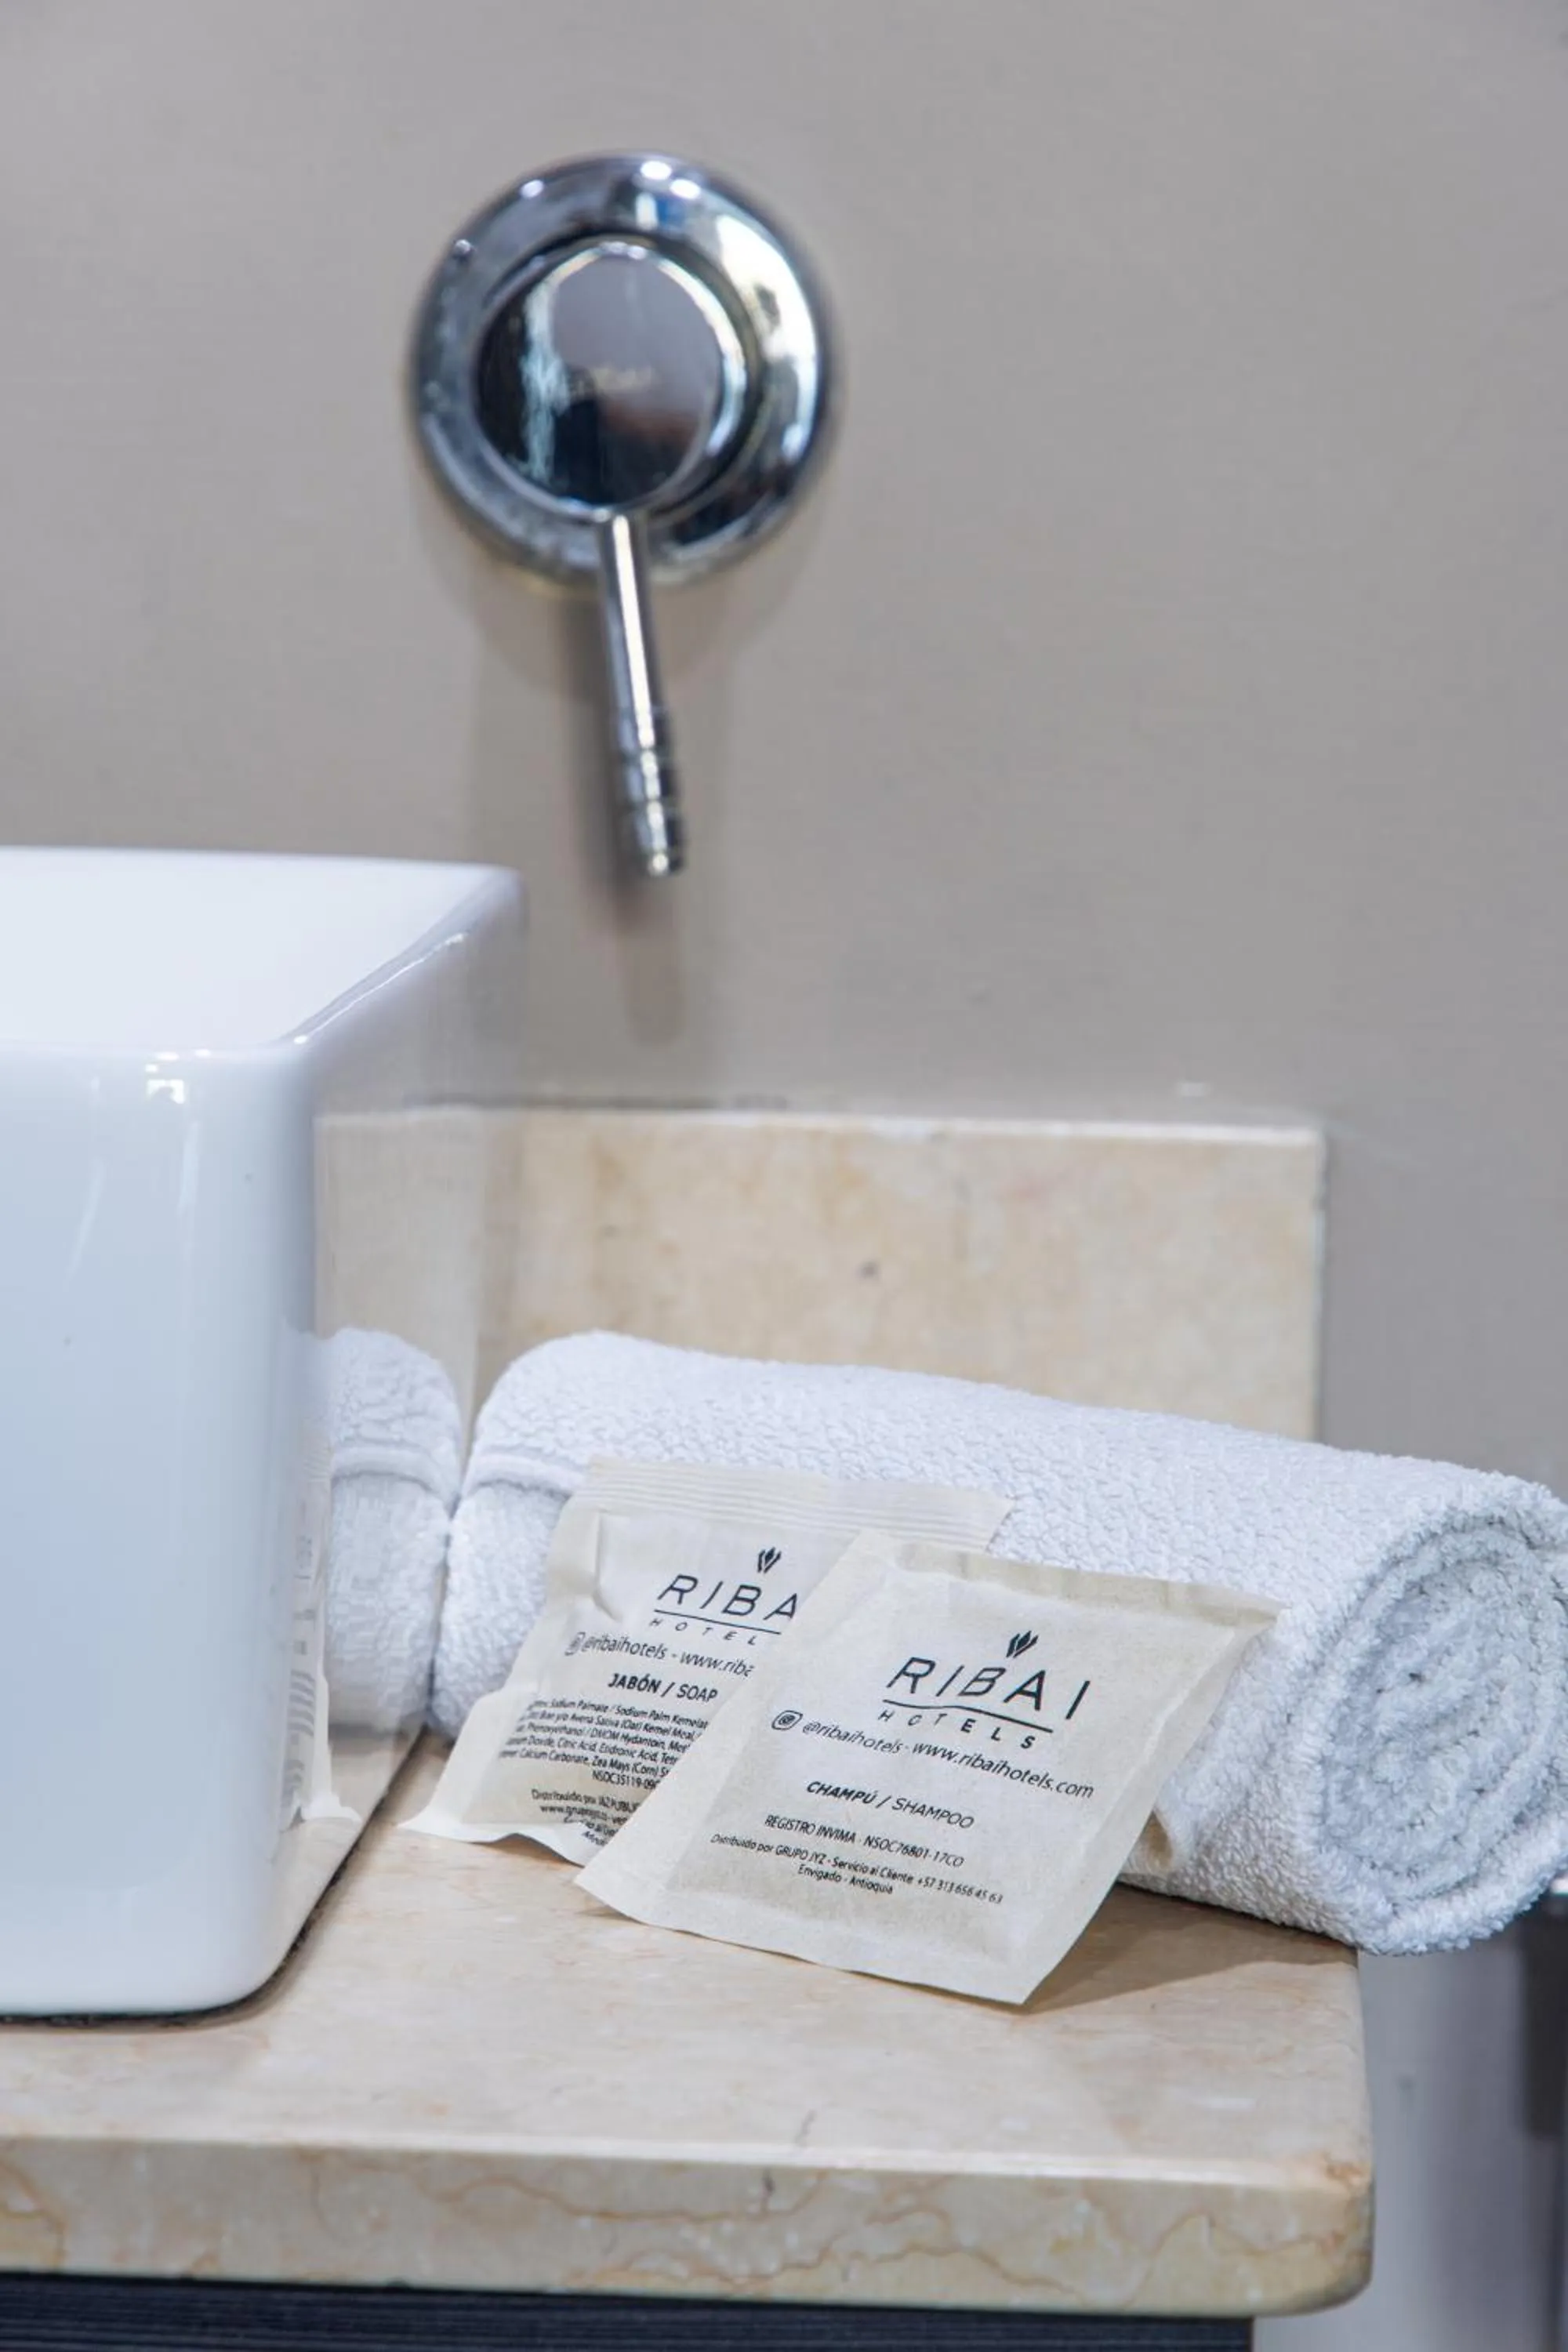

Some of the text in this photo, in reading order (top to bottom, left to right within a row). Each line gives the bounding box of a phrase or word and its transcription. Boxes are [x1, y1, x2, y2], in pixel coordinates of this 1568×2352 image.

[608, 1672, 719, 1704] JABÓN / SOAP
[887, 1657, 1091, 1720] RIBAI
[877, 1709, 1036, 1750] HOTELS
[802, 1721, 902, 1754] @ribaihotels
[913, 1742, 1094, 1798] www.ribaihotels.com
[806, 1780, 975, 1830] CHAMPÚ / SHAMPOO
[764, 1814, 816, 1836] REGISTRO
[815, 1824, 856, 1844] INVIMA
[710, 1834, 757, 1850] Distribuido
[757, 1842, 773, 1853] por
[775, 1845, 809, 1860] GRUPO
[832, 1857, 868, 1874] Servicio
[869, 1865, 878, 1876] al
[879, 1866, 914, 1884] Cliente
[954, 1884, 973, 1897] 656
[975, 1888, 987, 1901] 45
[989, 1892, 1004, 1905] 63
[797, 1863, 842, 1883] Envigado
[850, 1875, 894, 1895] Antioquia
